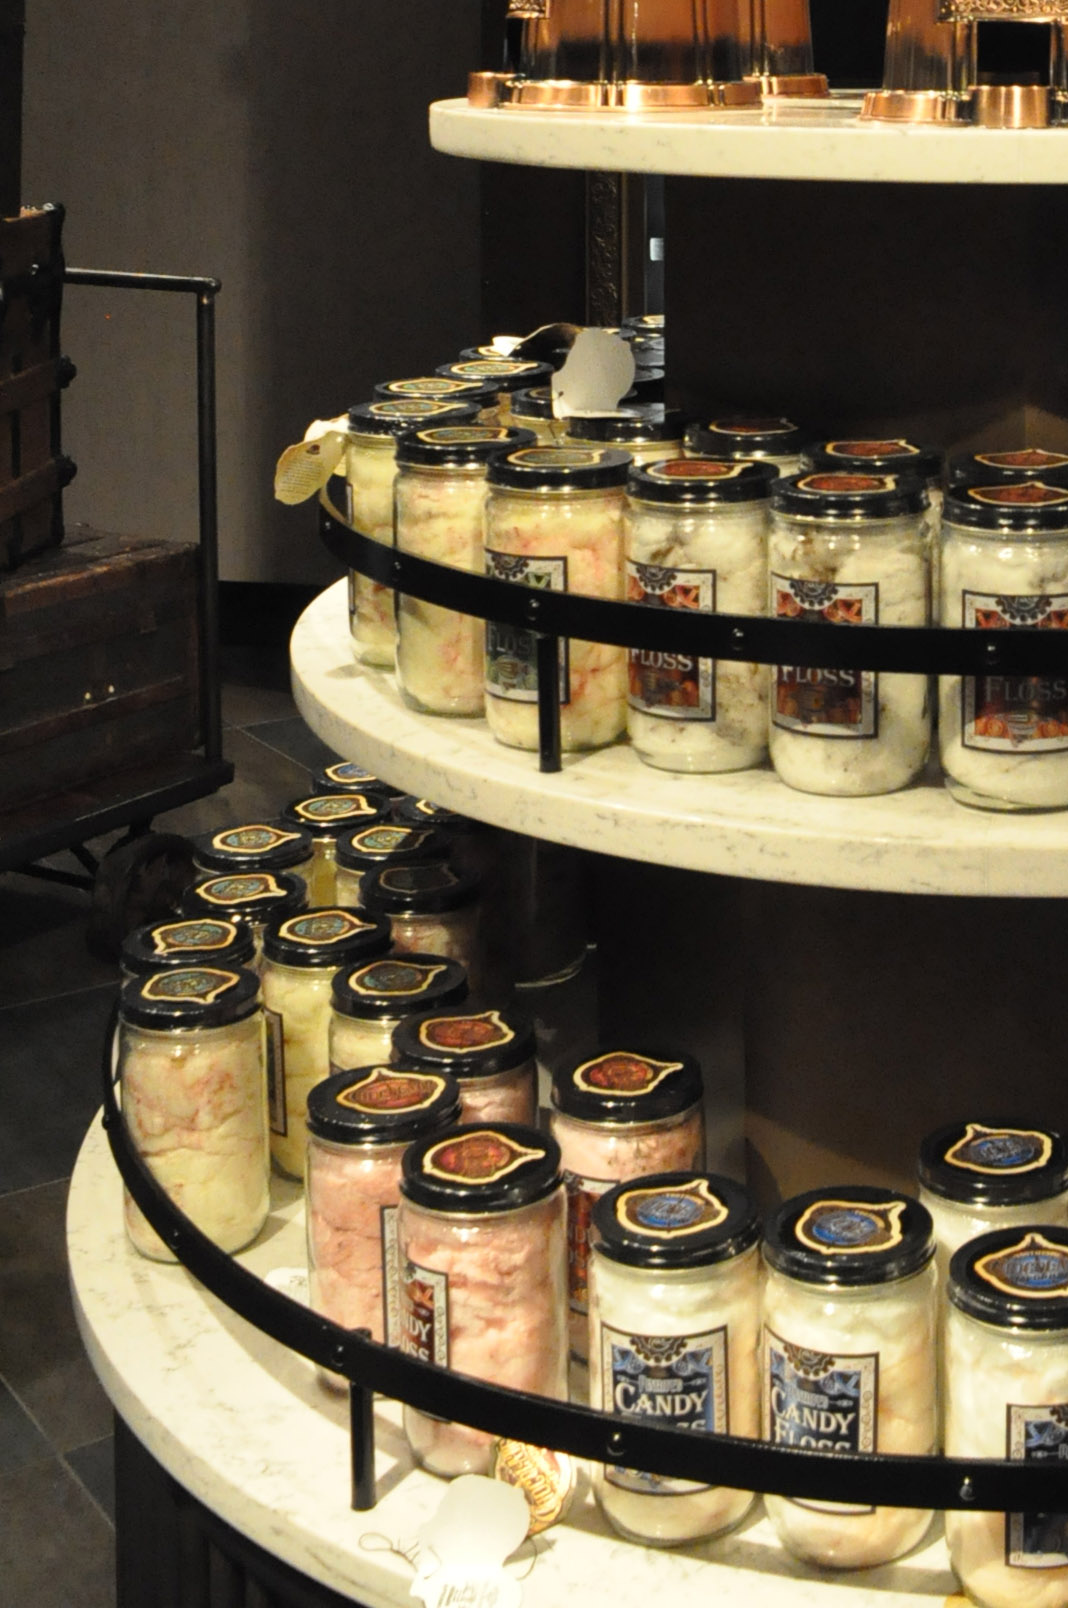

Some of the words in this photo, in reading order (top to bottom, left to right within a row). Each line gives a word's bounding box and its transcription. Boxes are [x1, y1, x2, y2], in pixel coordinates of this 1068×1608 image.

[631, 648, 693, 672] FLOSS
[781, 665, 855, 687] FLOSS
[985, 675, 1067, 703] FLOSS
[615, 1382, 708, 1416] CANDY
[771, 1386, 855, 1435] CANDY
